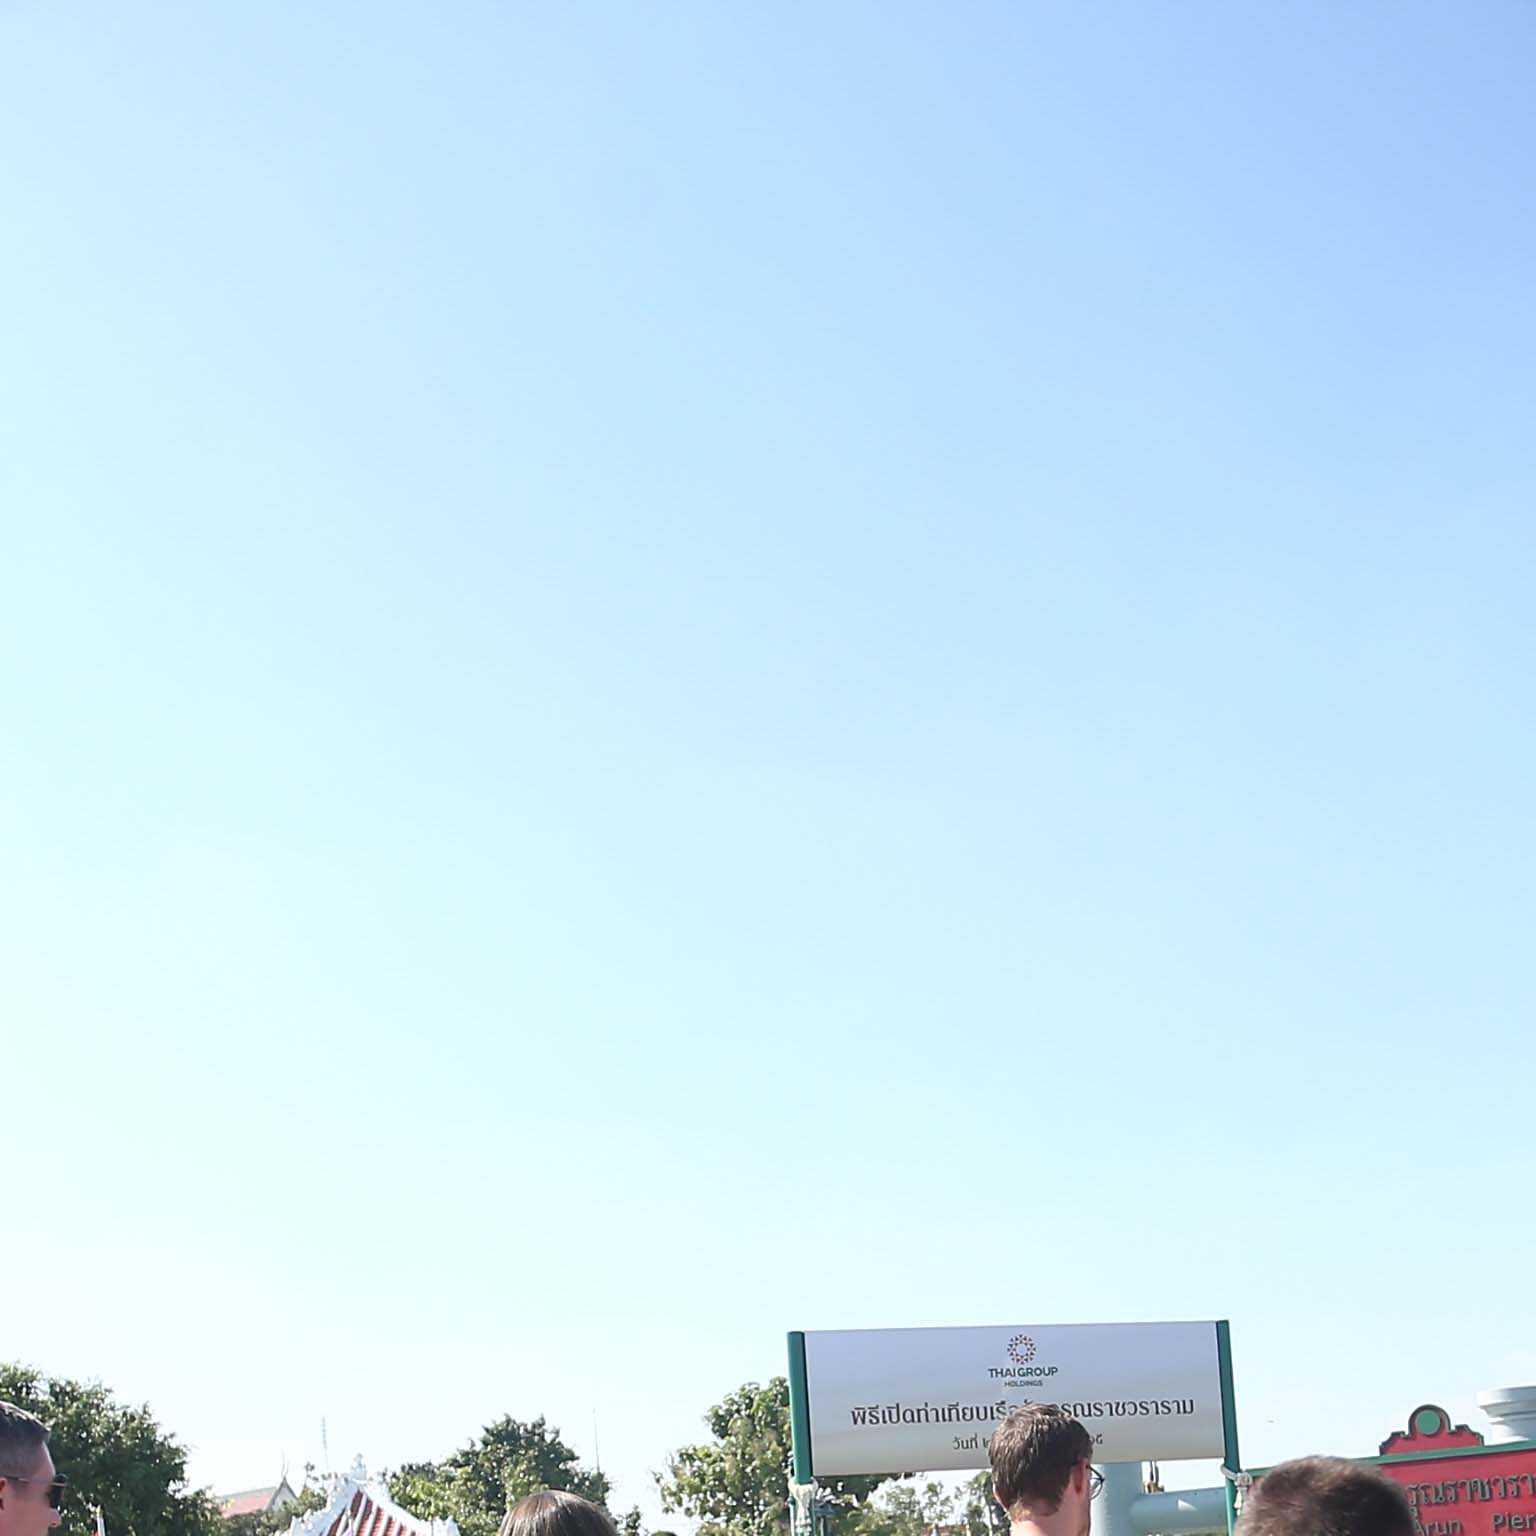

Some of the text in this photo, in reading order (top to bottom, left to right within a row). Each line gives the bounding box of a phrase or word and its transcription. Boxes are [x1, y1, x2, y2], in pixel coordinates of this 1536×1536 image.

[987, 1366, 1058, 1378] THAI GROUP
[1004, 1379, 1043, 1387] HOLDINGS
[1492, 1511, 1536, 1531] Pier
